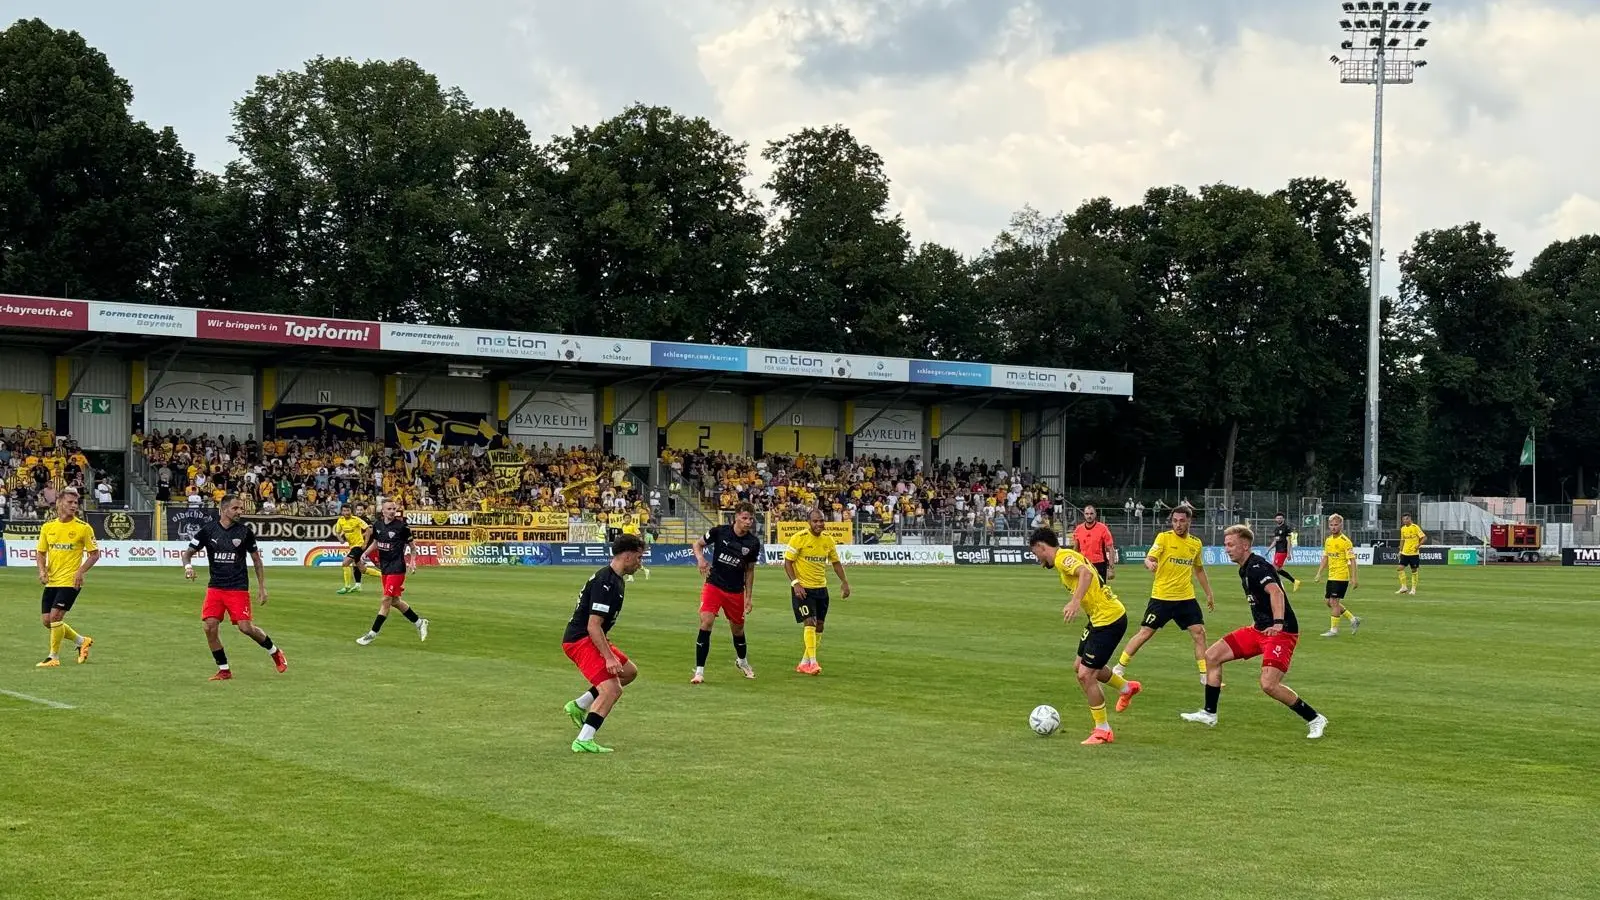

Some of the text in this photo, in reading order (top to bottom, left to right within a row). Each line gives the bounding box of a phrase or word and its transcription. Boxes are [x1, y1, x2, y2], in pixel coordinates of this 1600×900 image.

[99, 309, 174, 321] Formentechnik
[137, 320, 183, 329] Bayreuth
[207, 319, 278, 331] Wir bringen's in
[285, 321, 370, 341] Topform!
[391, 330, 454, 340] Formentechnik
[477, 335, 547, 349] motion
[602, 353, 632, 362] schlaeger
[663, 351, 739, 362] schlaeger.com/karriere
[764, 354, 823, 367] motion
[1006, 370, 1057, 382] motion
[320, 392, 329, 403] N
[154, 396, 245, 413] BAYREUTH
[515, 412, 587, 428] BAYREUTH
[858, 428, 916, 442] BAYREUTH
[1177, 466, 1182, 475] P
[112, 512, 126, 522] 25
[406, 513, 433, 525] SZENE
[449, 513, 469, 525] 1921
[411, 530, 471, 541] EGENGERADE
[489, 531, 518, 541] SPVGG
[523, 532, 567, 541] BAYREUTH
[404, 546, 544, 556] ARBE IST UNSER LEBEN.
[864, 551, 937, 561] WEDLICH.COM
[956, 548, 990, 562] capelli
[437, 556, 508, 564] www.swcolor.de
[799, 605, 809, 616] 10
